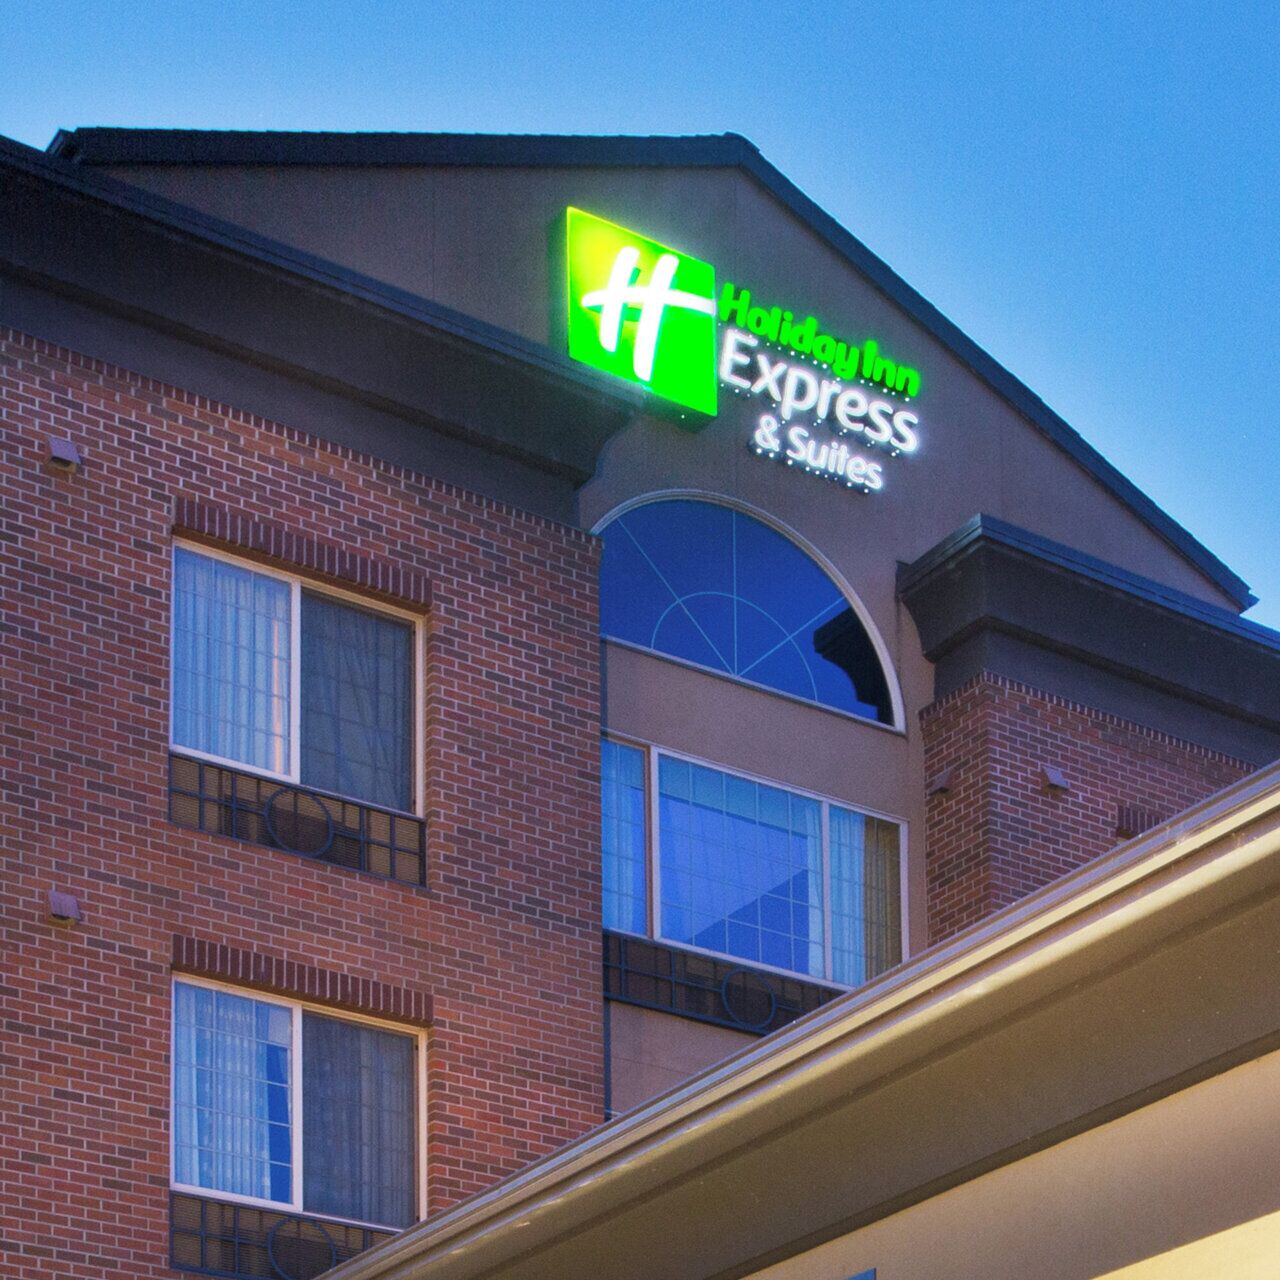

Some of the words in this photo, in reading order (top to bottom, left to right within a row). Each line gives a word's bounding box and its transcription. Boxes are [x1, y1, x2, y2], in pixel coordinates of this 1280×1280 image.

[719, 281, 860, 380] Holiday
[860, 340, 920, 397] Inn
[719, 328, 920, 453] Express
[753, 413, 780, 452] &
[786, 426, 884, 490] Suites
